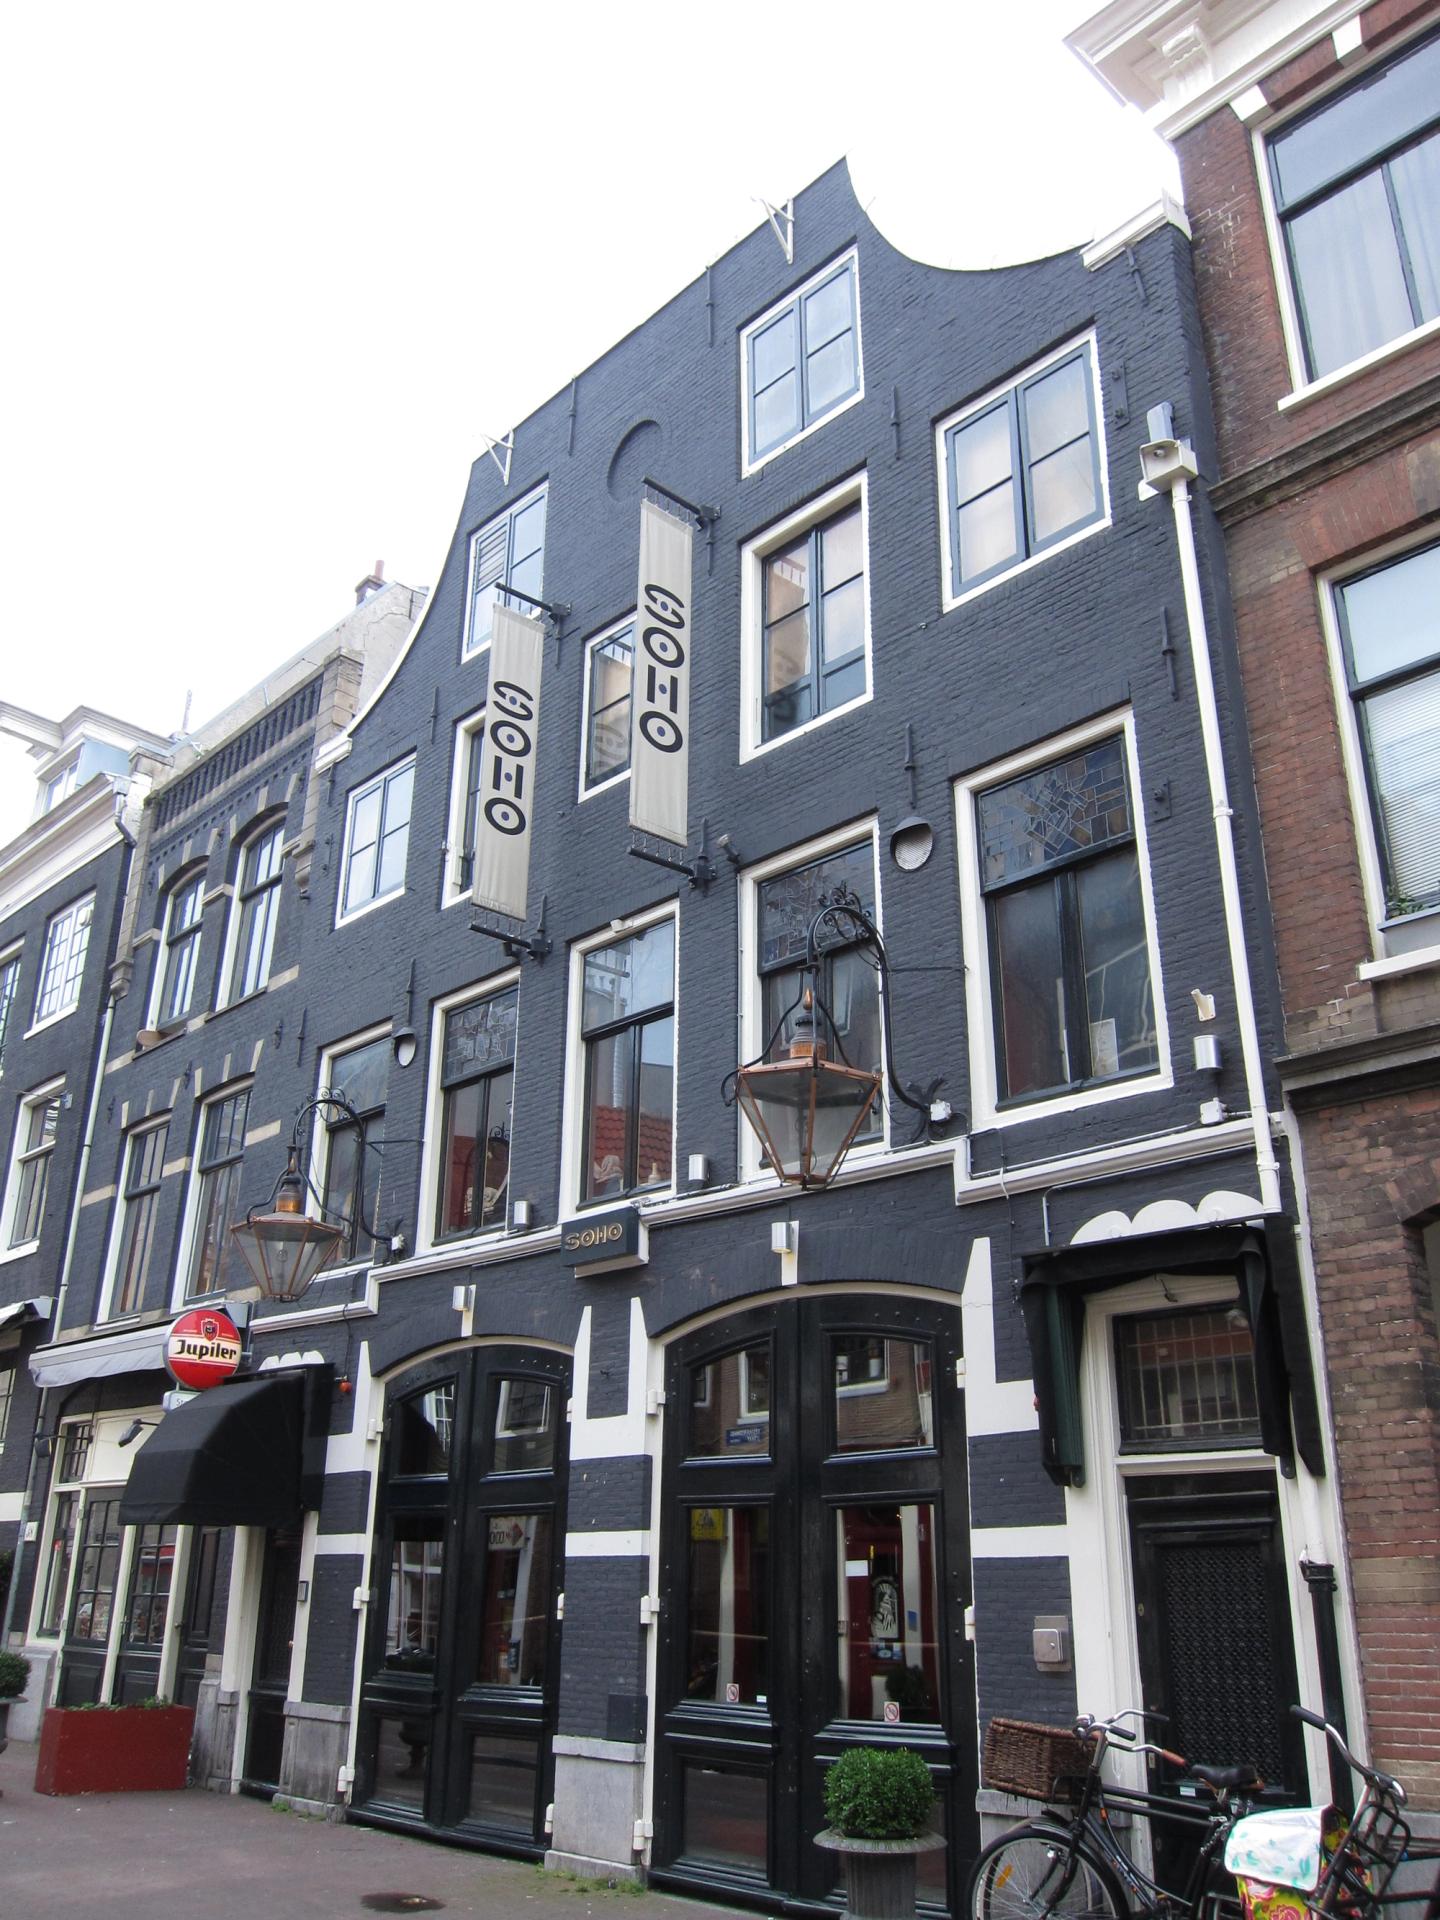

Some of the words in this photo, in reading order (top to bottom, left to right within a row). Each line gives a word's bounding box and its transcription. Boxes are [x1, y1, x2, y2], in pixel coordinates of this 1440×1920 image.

[640, 583, 685, 753] SOHO
[484, 680, 533, 836] SOHO
[564, 1222, 623, 1251] SOHO
[174, 1339, 237, 1360] Jupiler
